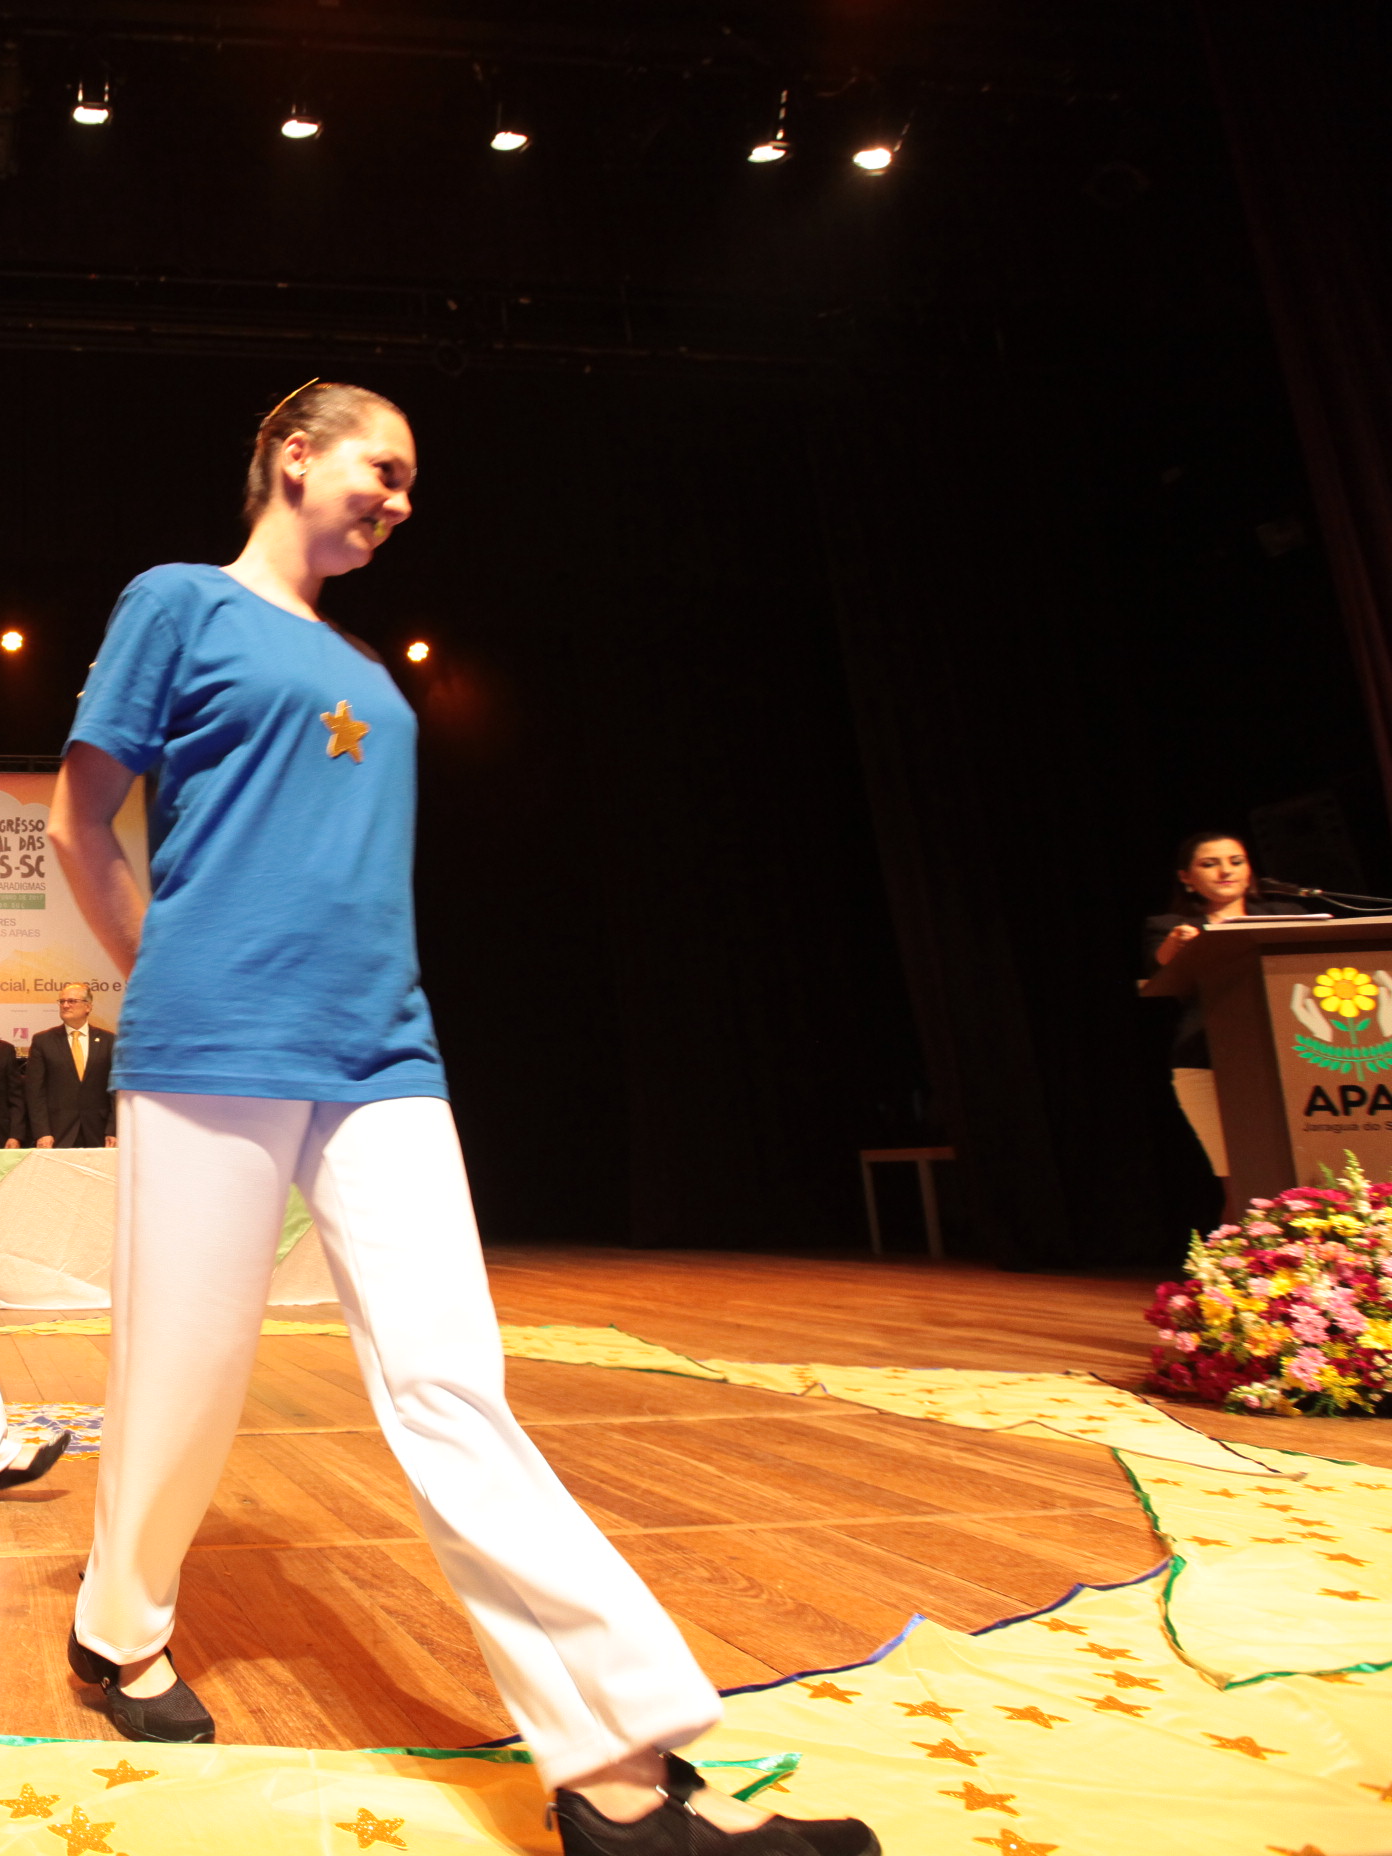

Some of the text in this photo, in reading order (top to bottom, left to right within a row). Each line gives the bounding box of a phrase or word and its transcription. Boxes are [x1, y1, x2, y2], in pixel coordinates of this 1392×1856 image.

[19, 835, 45, 851] DAS
[9, 929, 40, 938] APAES
[113, 981, 122, 992] e
